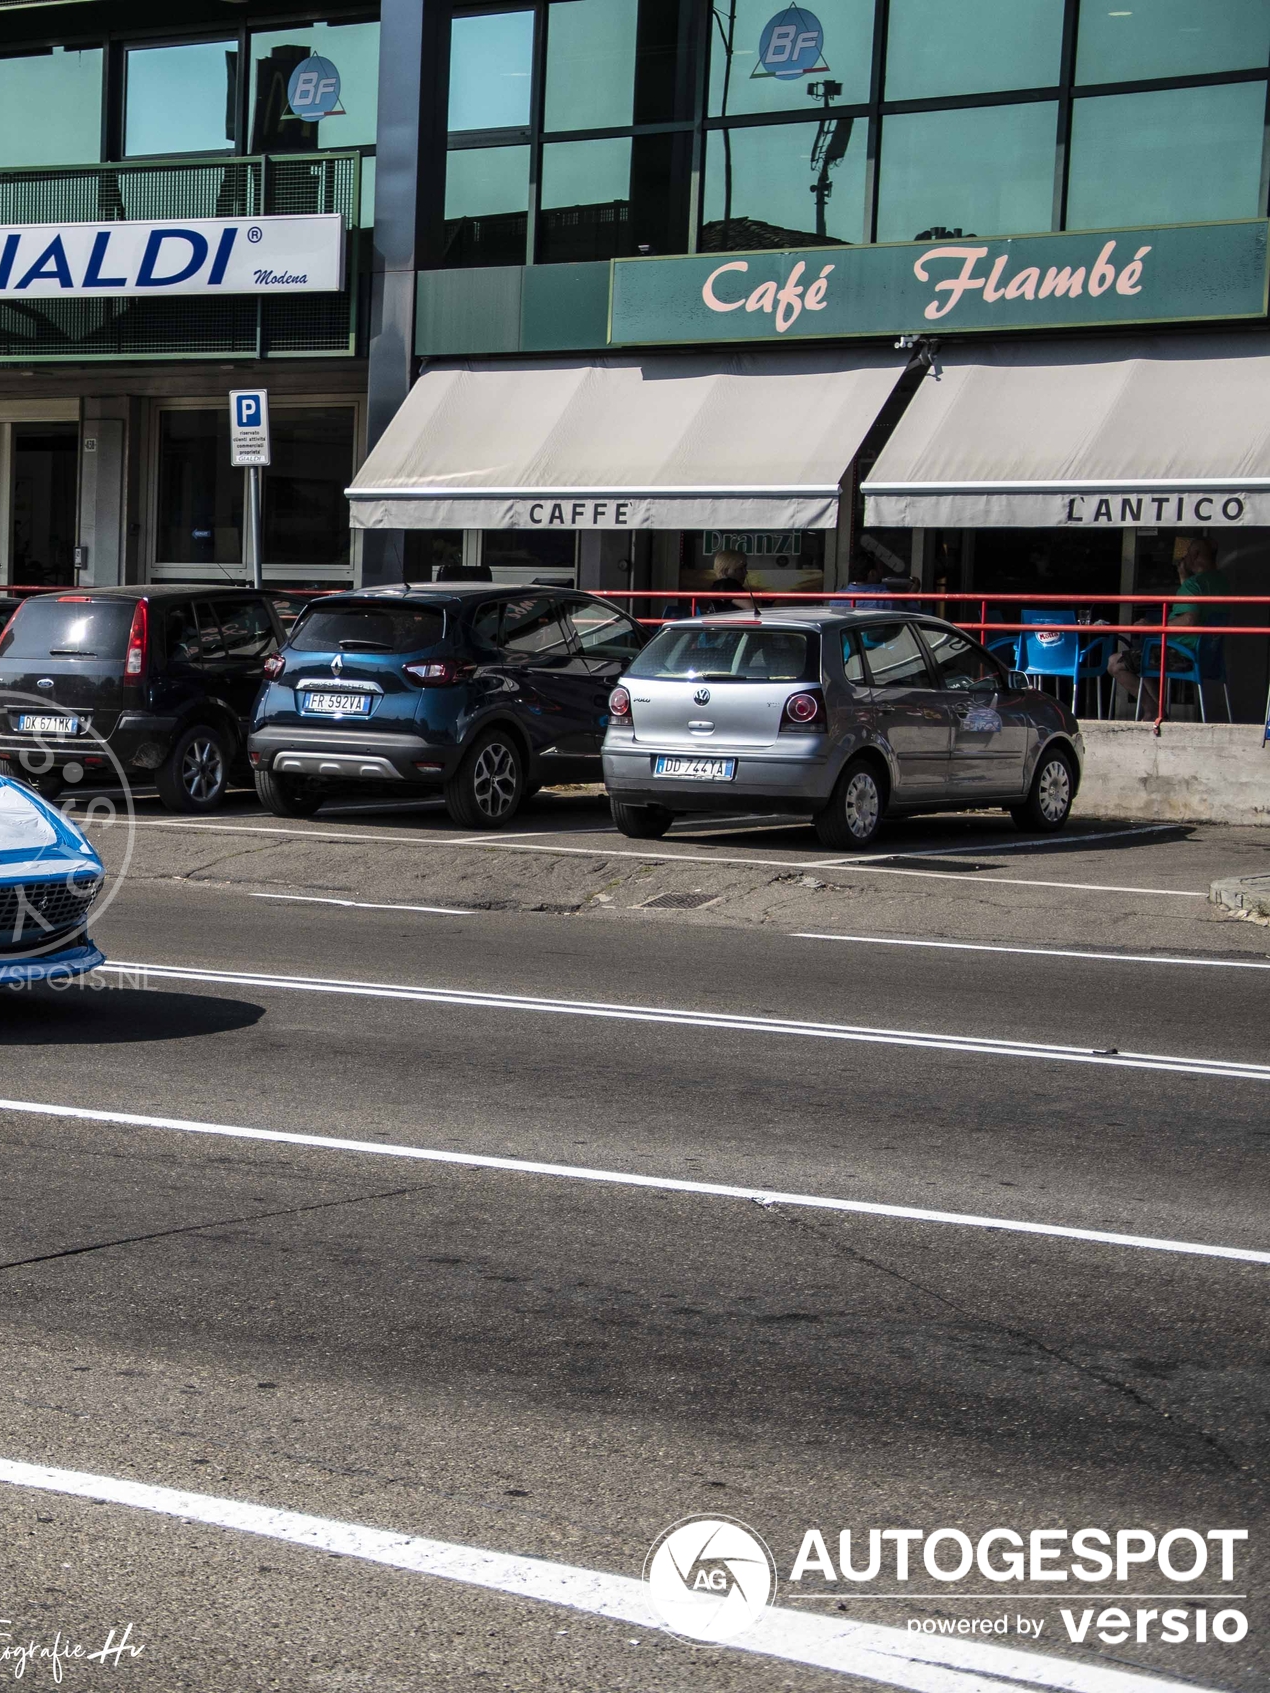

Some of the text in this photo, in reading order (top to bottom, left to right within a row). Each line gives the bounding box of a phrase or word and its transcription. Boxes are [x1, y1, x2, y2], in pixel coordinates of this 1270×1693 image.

[766, 23, 821, 65] BF
[292, 71, 337, 107] BF
[253, 268, 309, 286] Modena
[701, 239, 1153, 334] Café Flambé
[241, 399, 257, 423] P
[703, 529, 802, 556] Pranzi
[310, 694, 362, 710] FR 592VA
[25, 716, 71, 732] DK 671MK
[665, 757, 724, 776] DD 744YA
